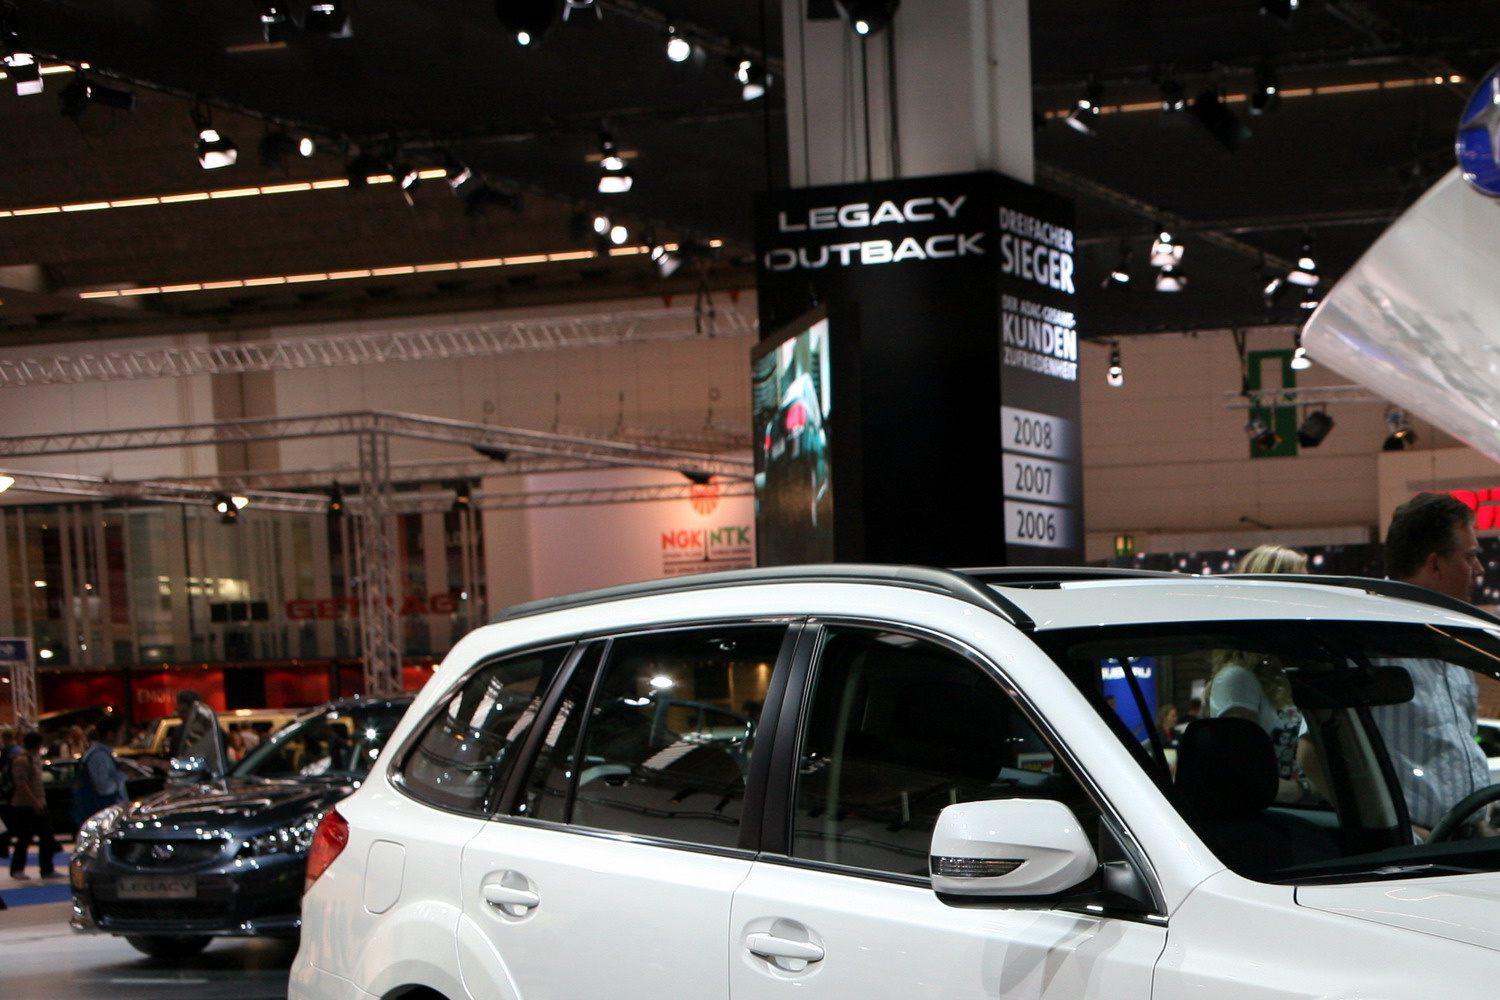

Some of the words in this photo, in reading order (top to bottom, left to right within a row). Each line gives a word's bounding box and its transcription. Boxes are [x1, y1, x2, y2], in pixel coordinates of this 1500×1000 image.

[778, 195, 967, 232] LEGACY
[1000, 206, 1074, 253] DREIFACHER
[764, 232, 985, 271] OUTBACK
[1001, 233, 1075, 295] SIEGER
[1002, 312, 1077, 361] KUNDEN
[1014, 415, 1052, 450] 2008
[1015, 463, 1052, 495] 2007
[662, 529, 702, 550] NGK
[710, 526, 750, 547] NTK
[1017, 509, 1056, 541] 2006
